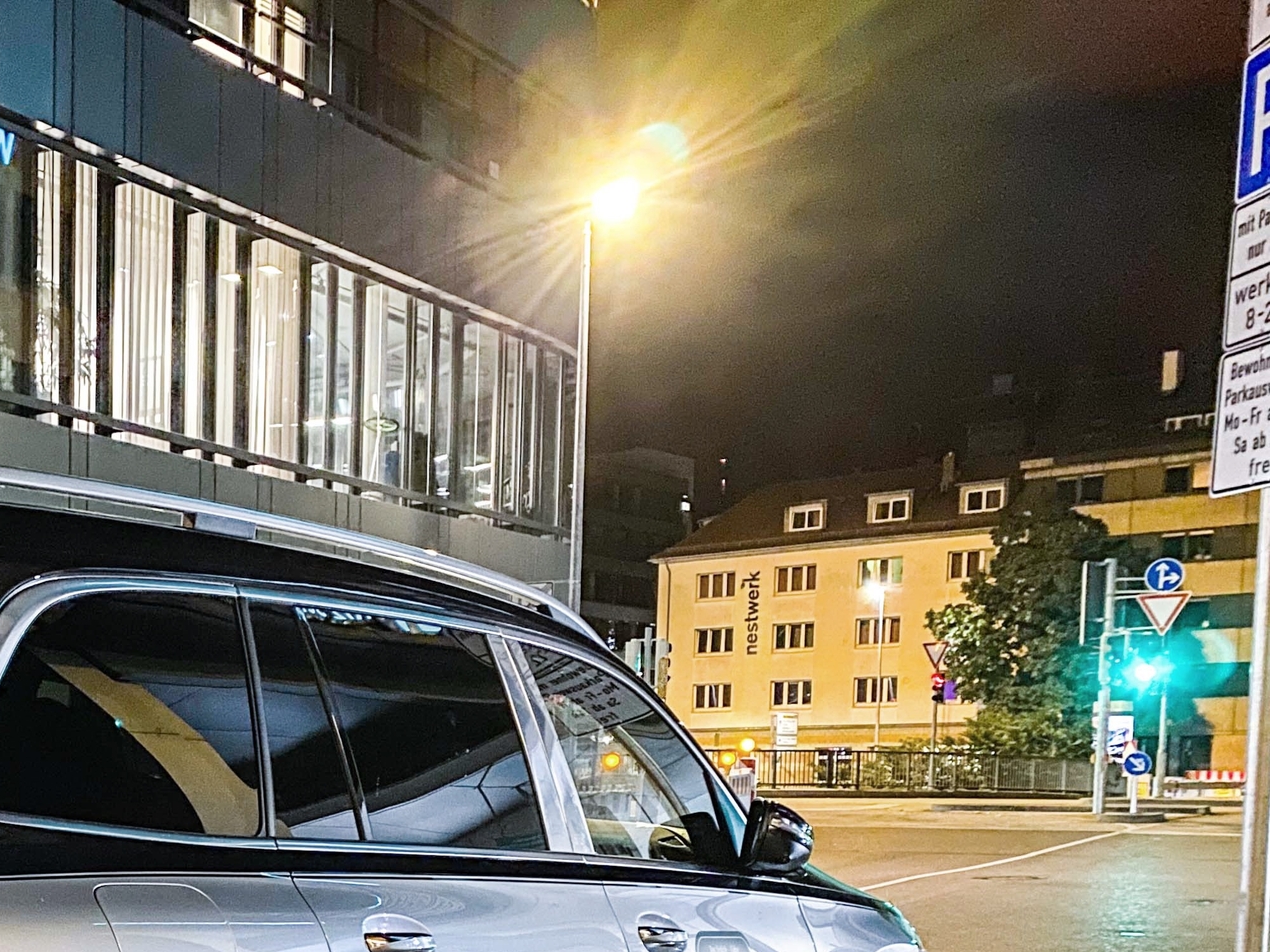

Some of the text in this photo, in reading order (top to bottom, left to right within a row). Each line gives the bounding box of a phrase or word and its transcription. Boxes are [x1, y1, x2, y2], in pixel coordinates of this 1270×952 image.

[1238, 215, 1255, 238] mit
[1248, 239, 1267, 261] nur
[1233, 430, 1266, 454] Sa ab
[740, 570, 761, 655] nestwerk
